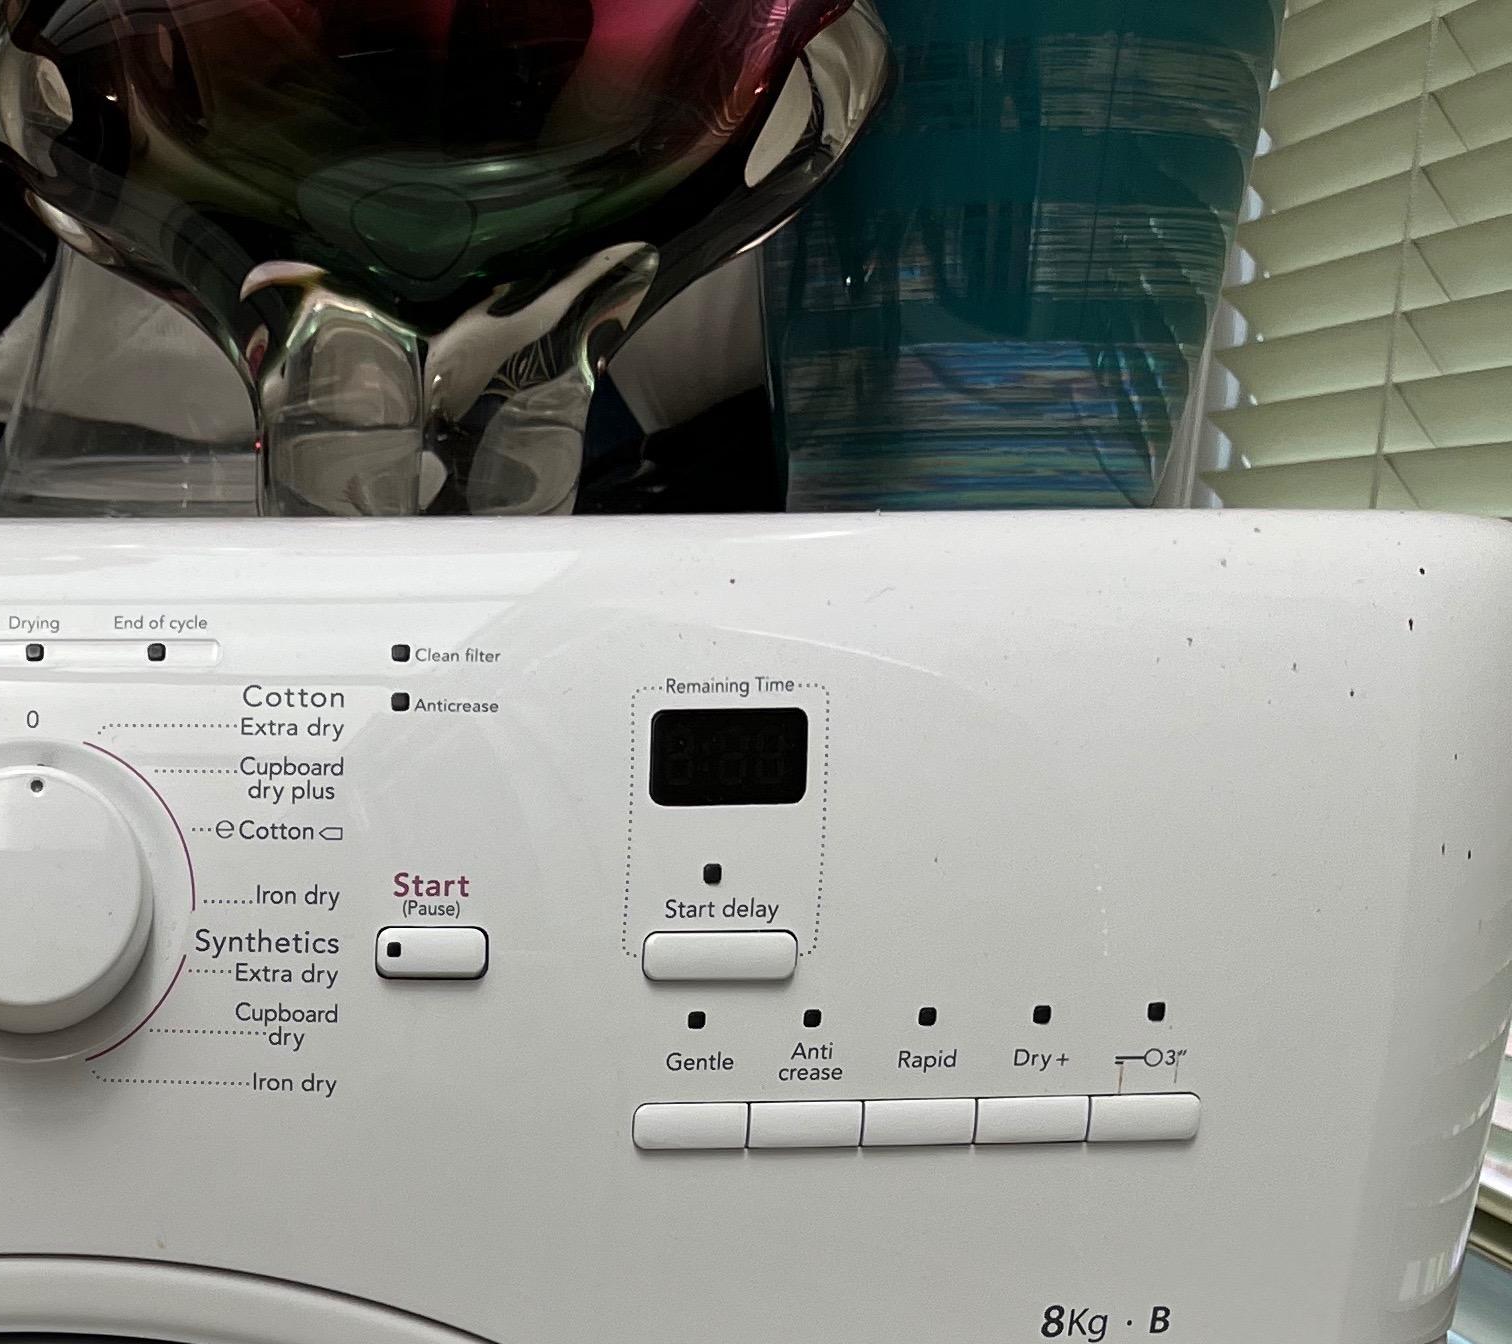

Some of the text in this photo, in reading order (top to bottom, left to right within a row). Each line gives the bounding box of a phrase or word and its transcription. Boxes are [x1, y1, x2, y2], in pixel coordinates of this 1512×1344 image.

[8, 615, 60, 634] Drying
[114, 615, 208, 633] End of cycle
[415, 648, 501, 663] Clean filter
[242, 685, 345, 708] Cotton
[665, 676, 795, 697] Remaining Time
[414, 699, 499, 714] Anticrease
[26, 710, 39, 729] 0
[240, 718, 345, 742] Extra dry
[240, 758, 344, 782] Cupboard
[248, 781, 335, 804] dry plus
[239, 819, 314, 840] Cotton
[393, 872, 470, 899] Start
[255, 885, 340, 911] Iron dry
[402, 901, 461, 919] (Pause)
[664, 899, 779, 923] Start delay
[194, 929, 340, 959] Synthetics
[235, 965, 339, 988] Extra dry
[235, 1004, 338, 1028] Cupboard
[268, 1028, 304, 1051] dry
[790, 1041, 834, 1061] Anti
[665, 1050, 734, 1072] Gentle
[898, 1048, 957, 1072] Rapid
[778, 1063, 843, 1082] crease
[252, 1074, 337, 1098] Iron dry
[1040, 1305, 1172, 1343] 8Kg B
